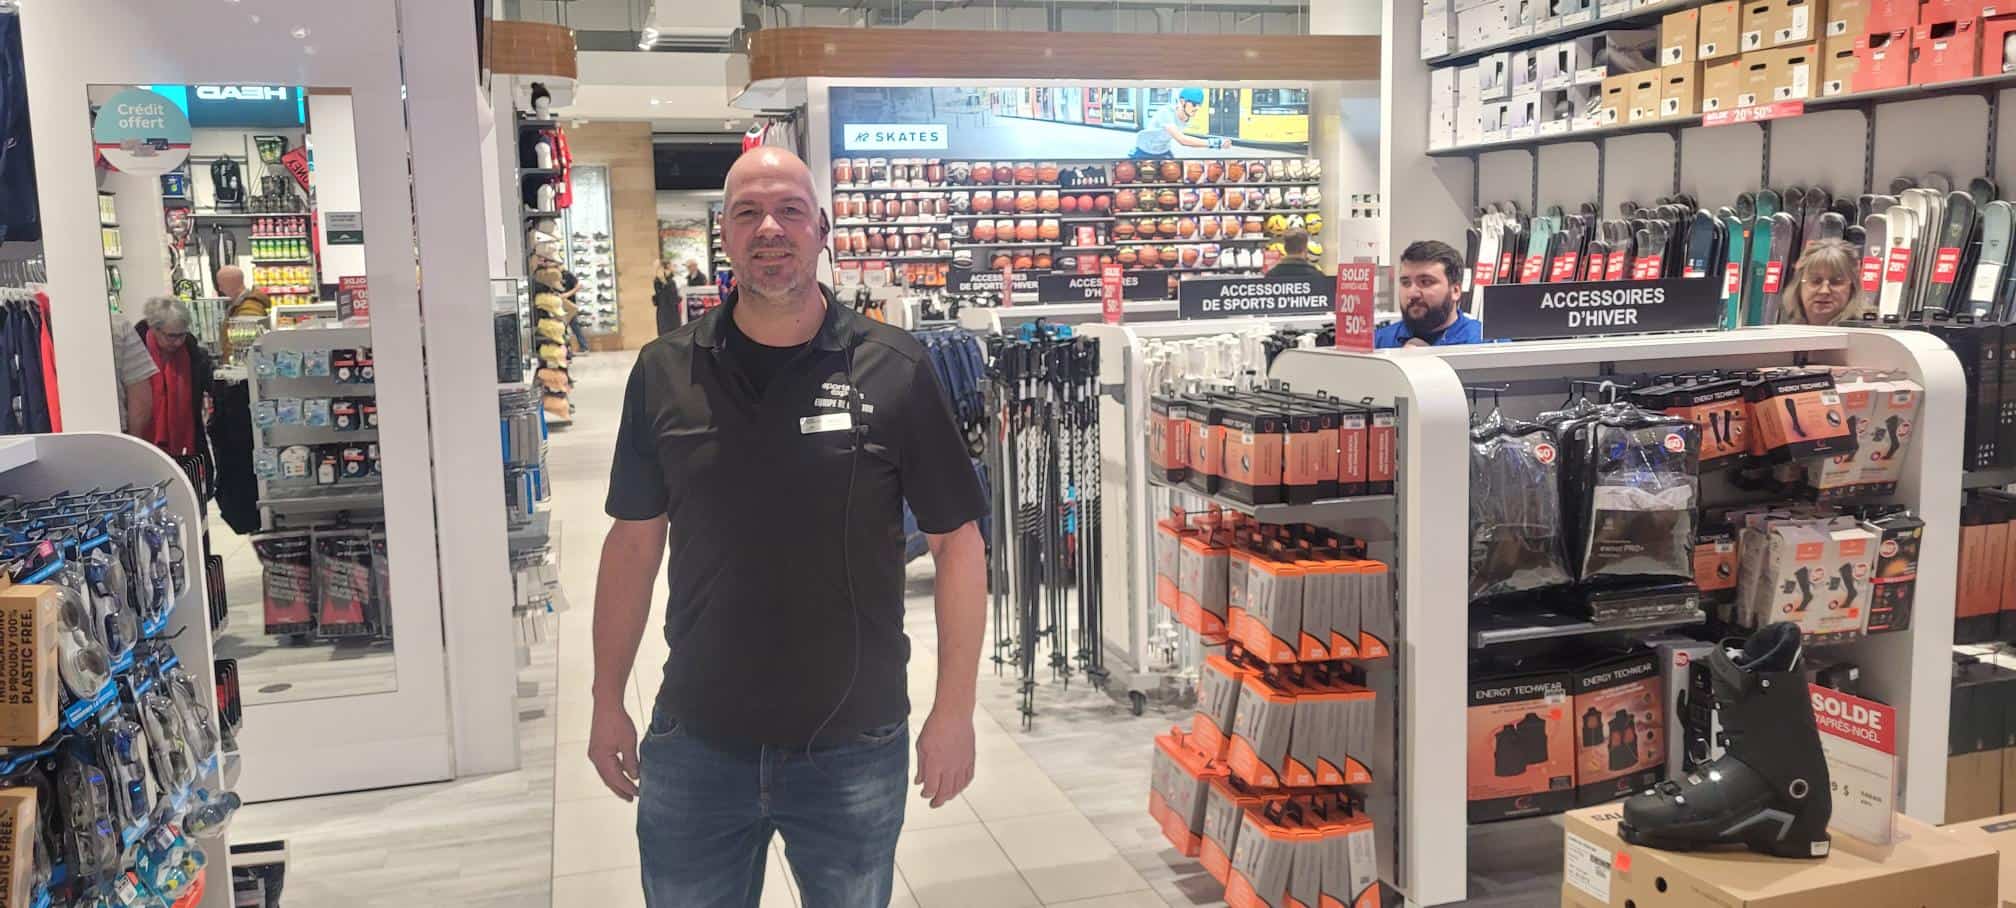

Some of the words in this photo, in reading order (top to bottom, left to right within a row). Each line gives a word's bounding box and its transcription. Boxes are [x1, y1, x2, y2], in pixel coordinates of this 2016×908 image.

[118, 103, 165, 115] Crédit
[119, 116, 165, 129] offert
[875, 132, 939, 142] SKATES
[970, 273, 1027, 282] ACCESSRES
[1342, 268, 1370, 281] SOLDE
[960, 282, 971, 291] DE
[1069, 277, 1139, 288] ACCESRES
[1220, 282, 1311, 297] ACCESSOIRES
[1202, 299, 1221, 311] DE
[1223, 297, 1275, 311] SPORTS
[1278, 295, 1328, 308] D'HIVER
[1540, 288, 1665, 309] ACCESSOIRES
[1568, 308, 1638, 328] D'HIVER
[21, 609, 33, 644] FREE.
[8, 641, 18, 691] PROUDLY
[21, 647, 33, 704] PLASTIC
[1583, 670, 1612, 687] ENERGY
[1614, 662, 1653, 680] TECHWEAR
[1475, 687, 1512, 700] ENERGY
[1514, 681, 1563, 697] TECHWEAR
[9, 693, 18, 704] IS
[1811, 692, 1882, 731] SOLDE
